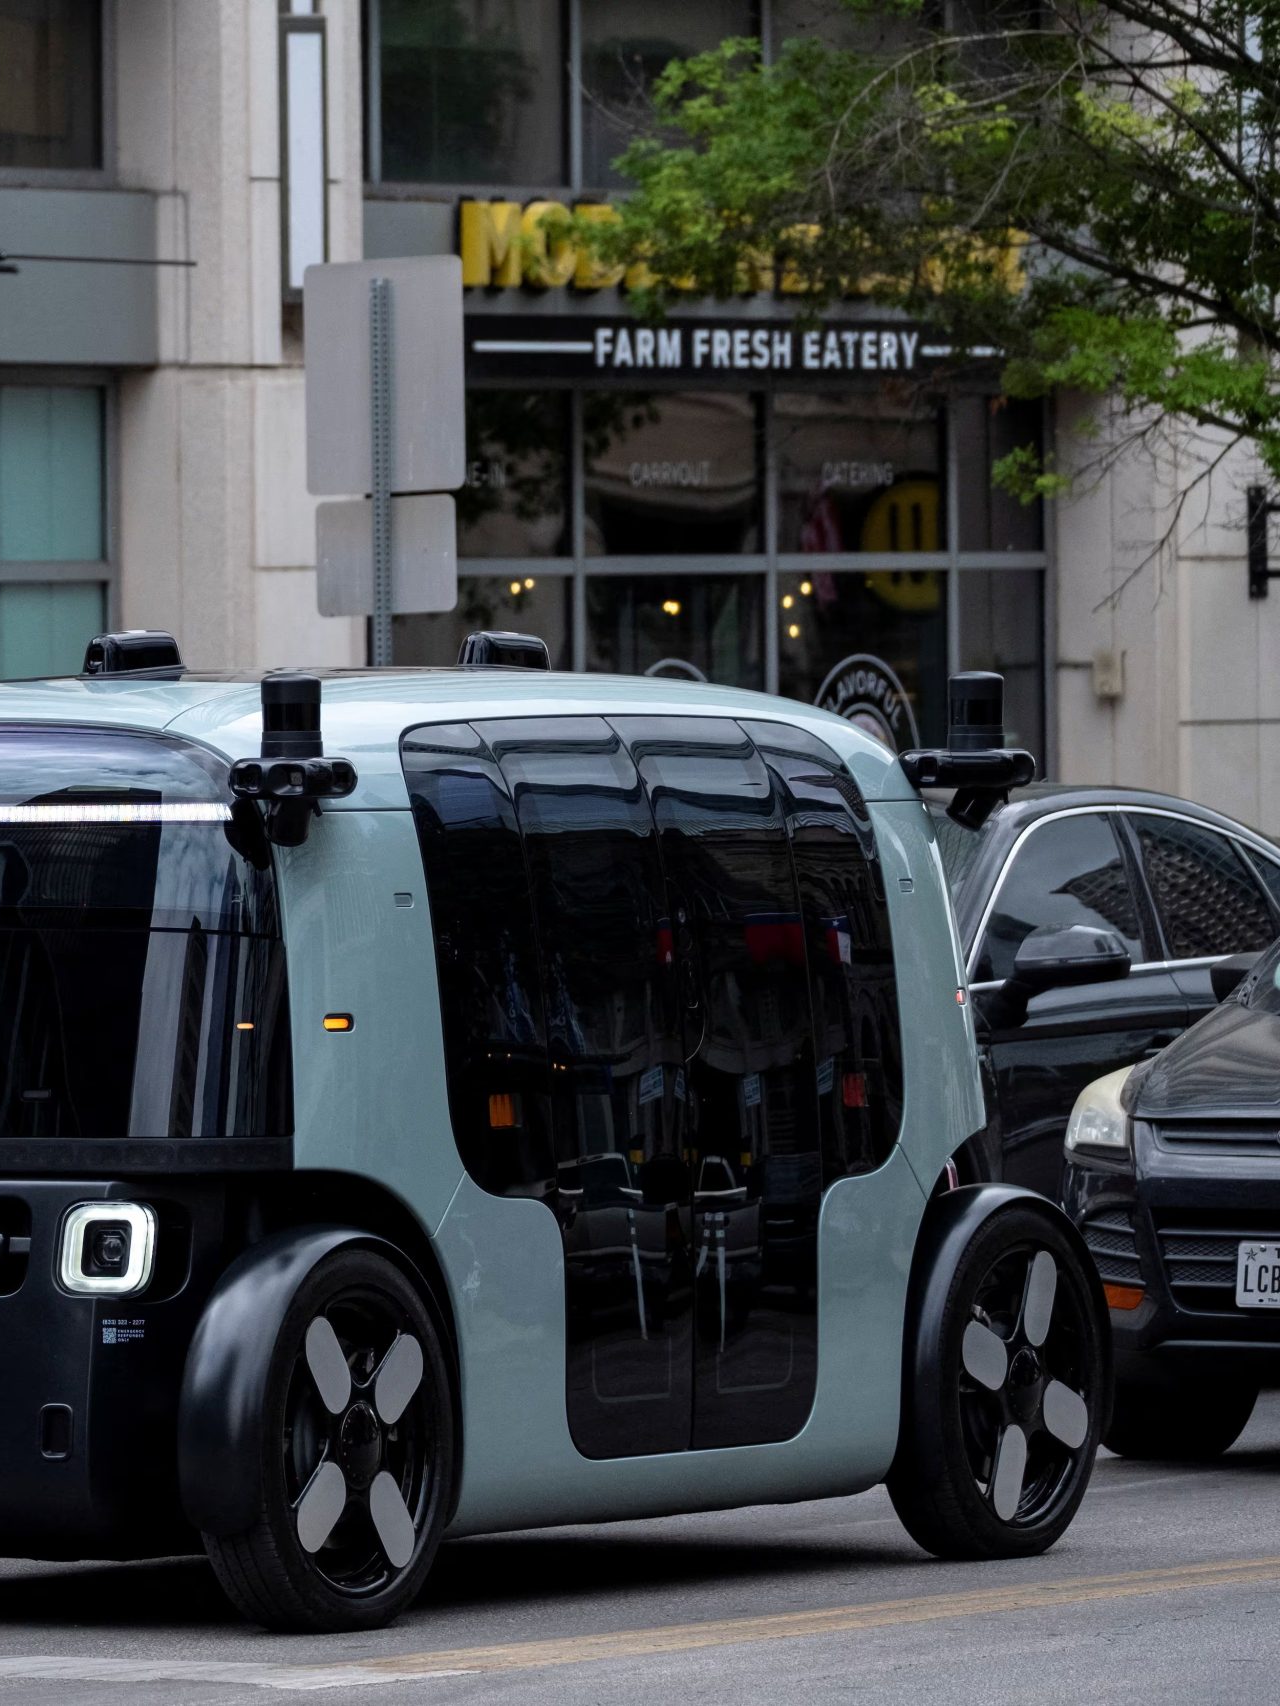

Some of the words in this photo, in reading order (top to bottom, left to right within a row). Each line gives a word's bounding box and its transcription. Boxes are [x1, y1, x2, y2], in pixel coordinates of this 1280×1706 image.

[594, 328, 682, 367] FARM
[692, 328, 792, 369] FRESH
[803, 331, 919, 370] EATERY
[822, 669, 902, 731] LAVORFUL
